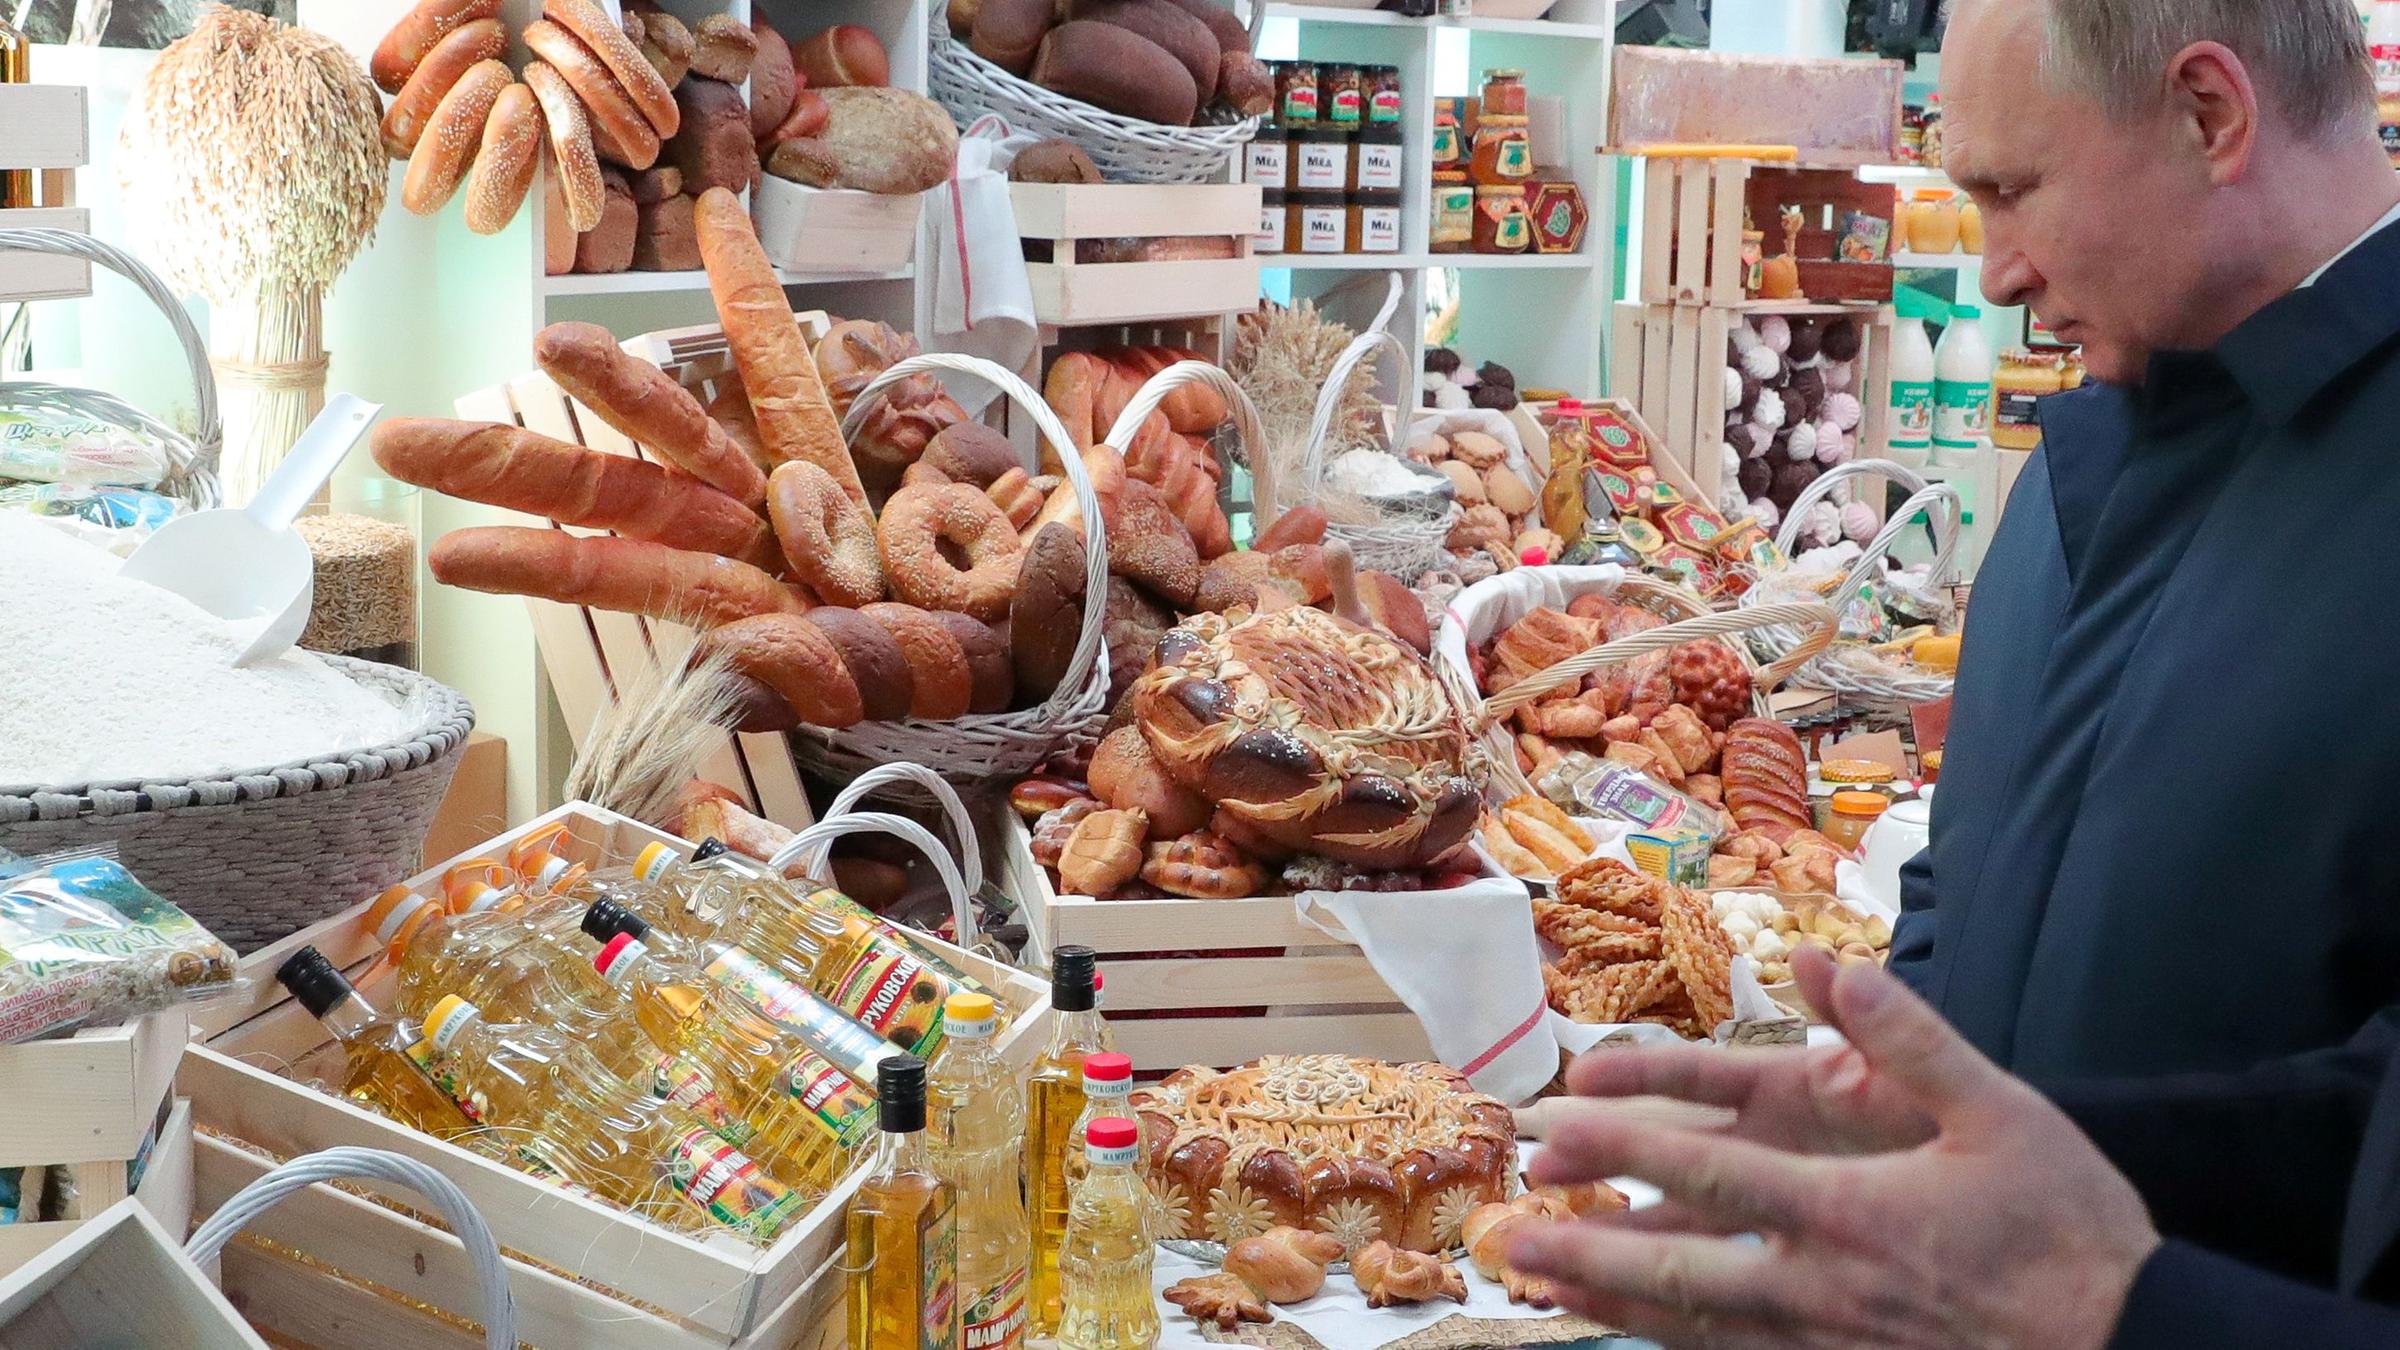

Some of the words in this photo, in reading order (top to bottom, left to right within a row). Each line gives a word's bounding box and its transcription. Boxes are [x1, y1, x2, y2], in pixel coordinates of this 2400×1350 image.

[1609, 781, 1631, 803] ЗНАК
[49, 968, 102, 994] продукт
[860, 956, 919, 1030] РУКОВСКО
